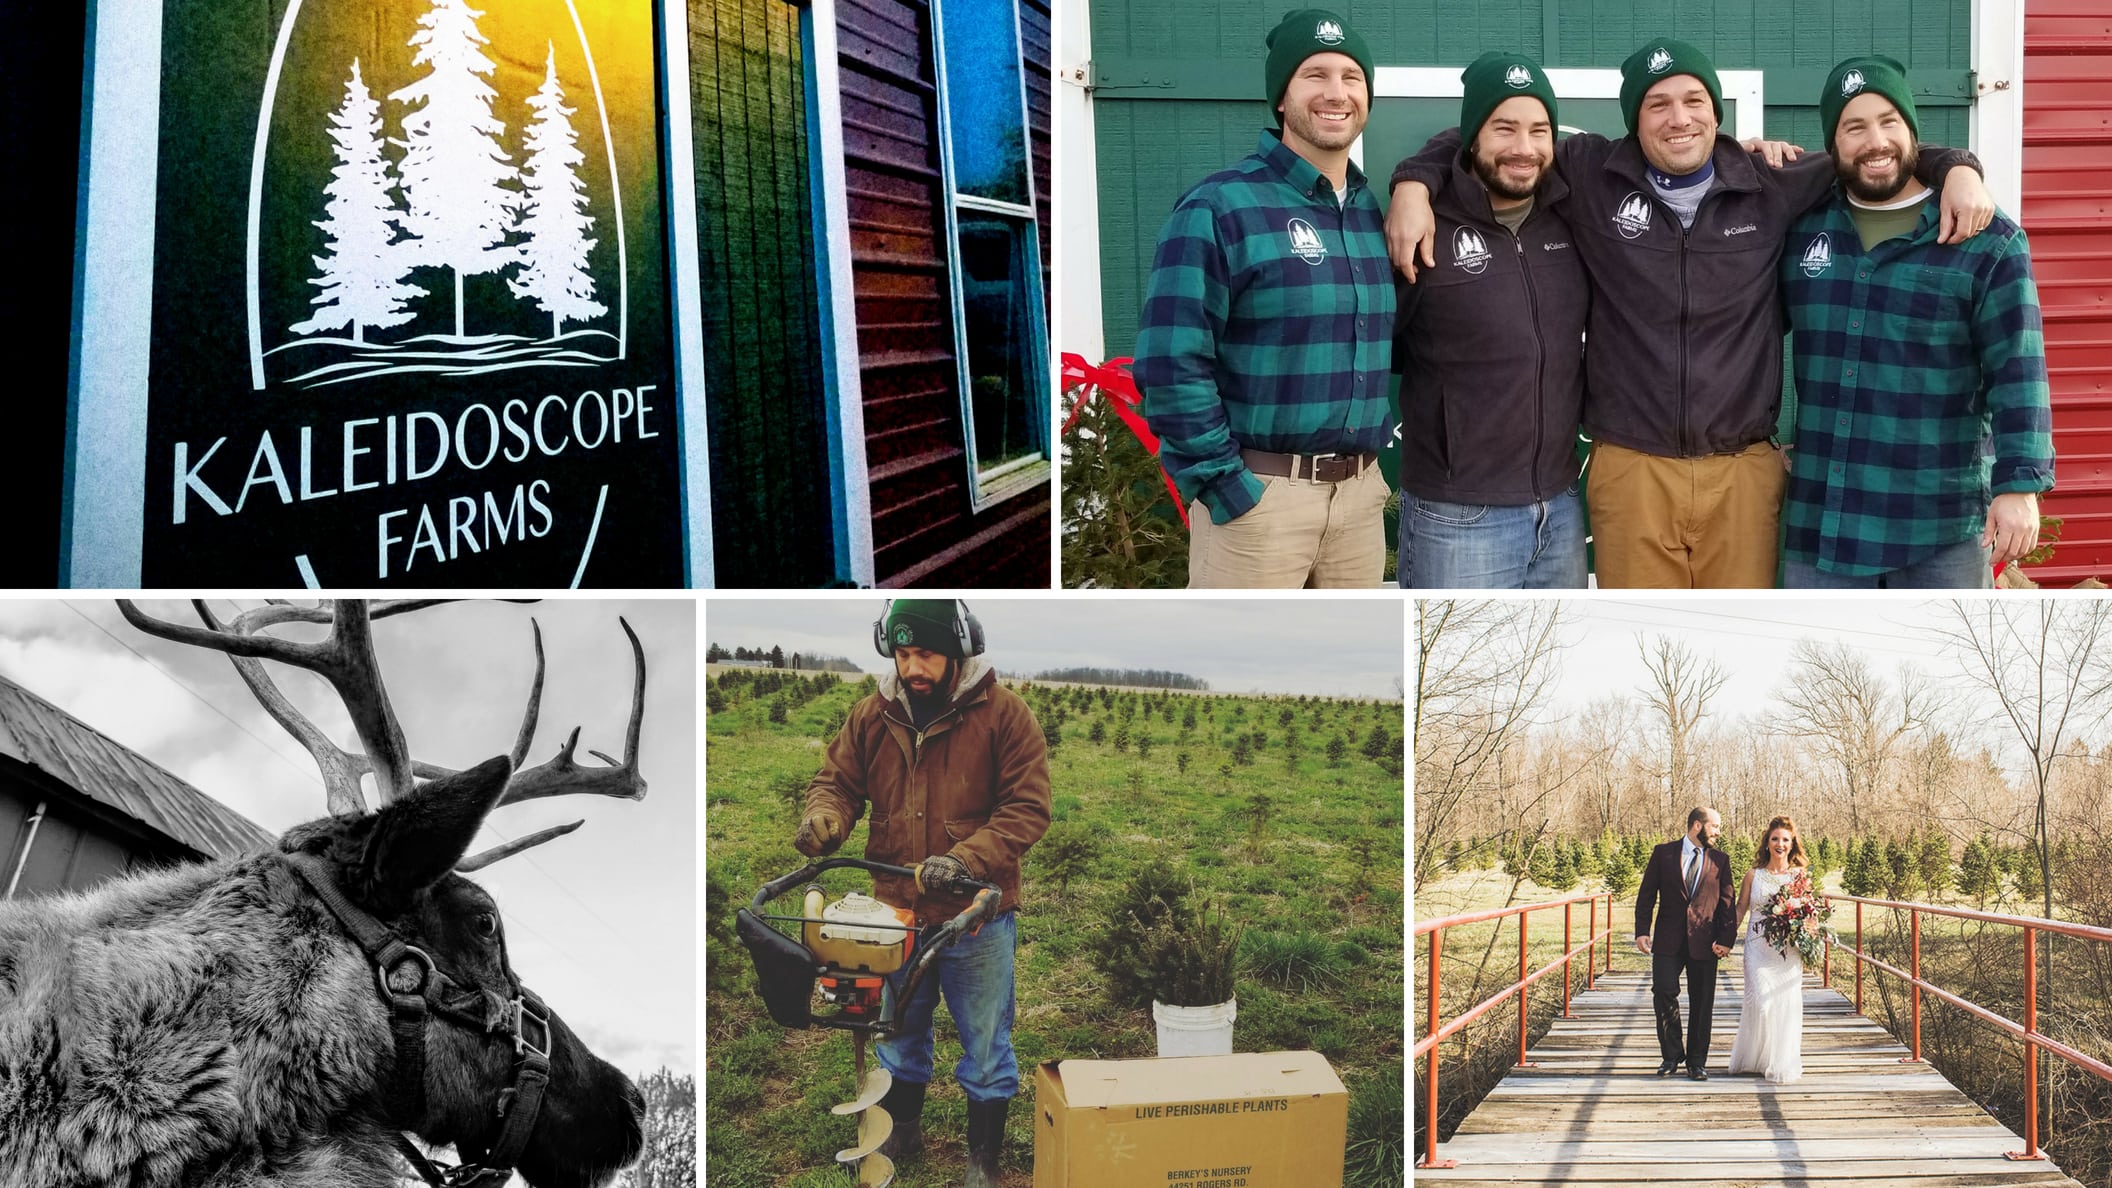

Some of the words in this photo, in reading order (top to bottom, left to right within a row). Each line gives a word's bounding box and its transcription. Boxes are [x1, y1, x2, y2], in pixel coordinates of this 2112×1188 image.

[1730, 223, 1757, 235] Columbia
[173, 385, 659, 524] KALEIDOSCOPE
[378, 479, 553, 578] FARMS
[1135, 1105, 1162, 1119] LIVE
[1165, 1102, 1239, 1117] PERISHABLE
[1242, 1098, 1288, 1113] PLANTS
[1167, 1168, 1209, 1180] BERKEY'S
[1211, 1166, 1252, 1177] NURSERY
[1196, 1179, 1232, 1188] ROGERS
[1233, 1178, 1249, 1188] RD.
